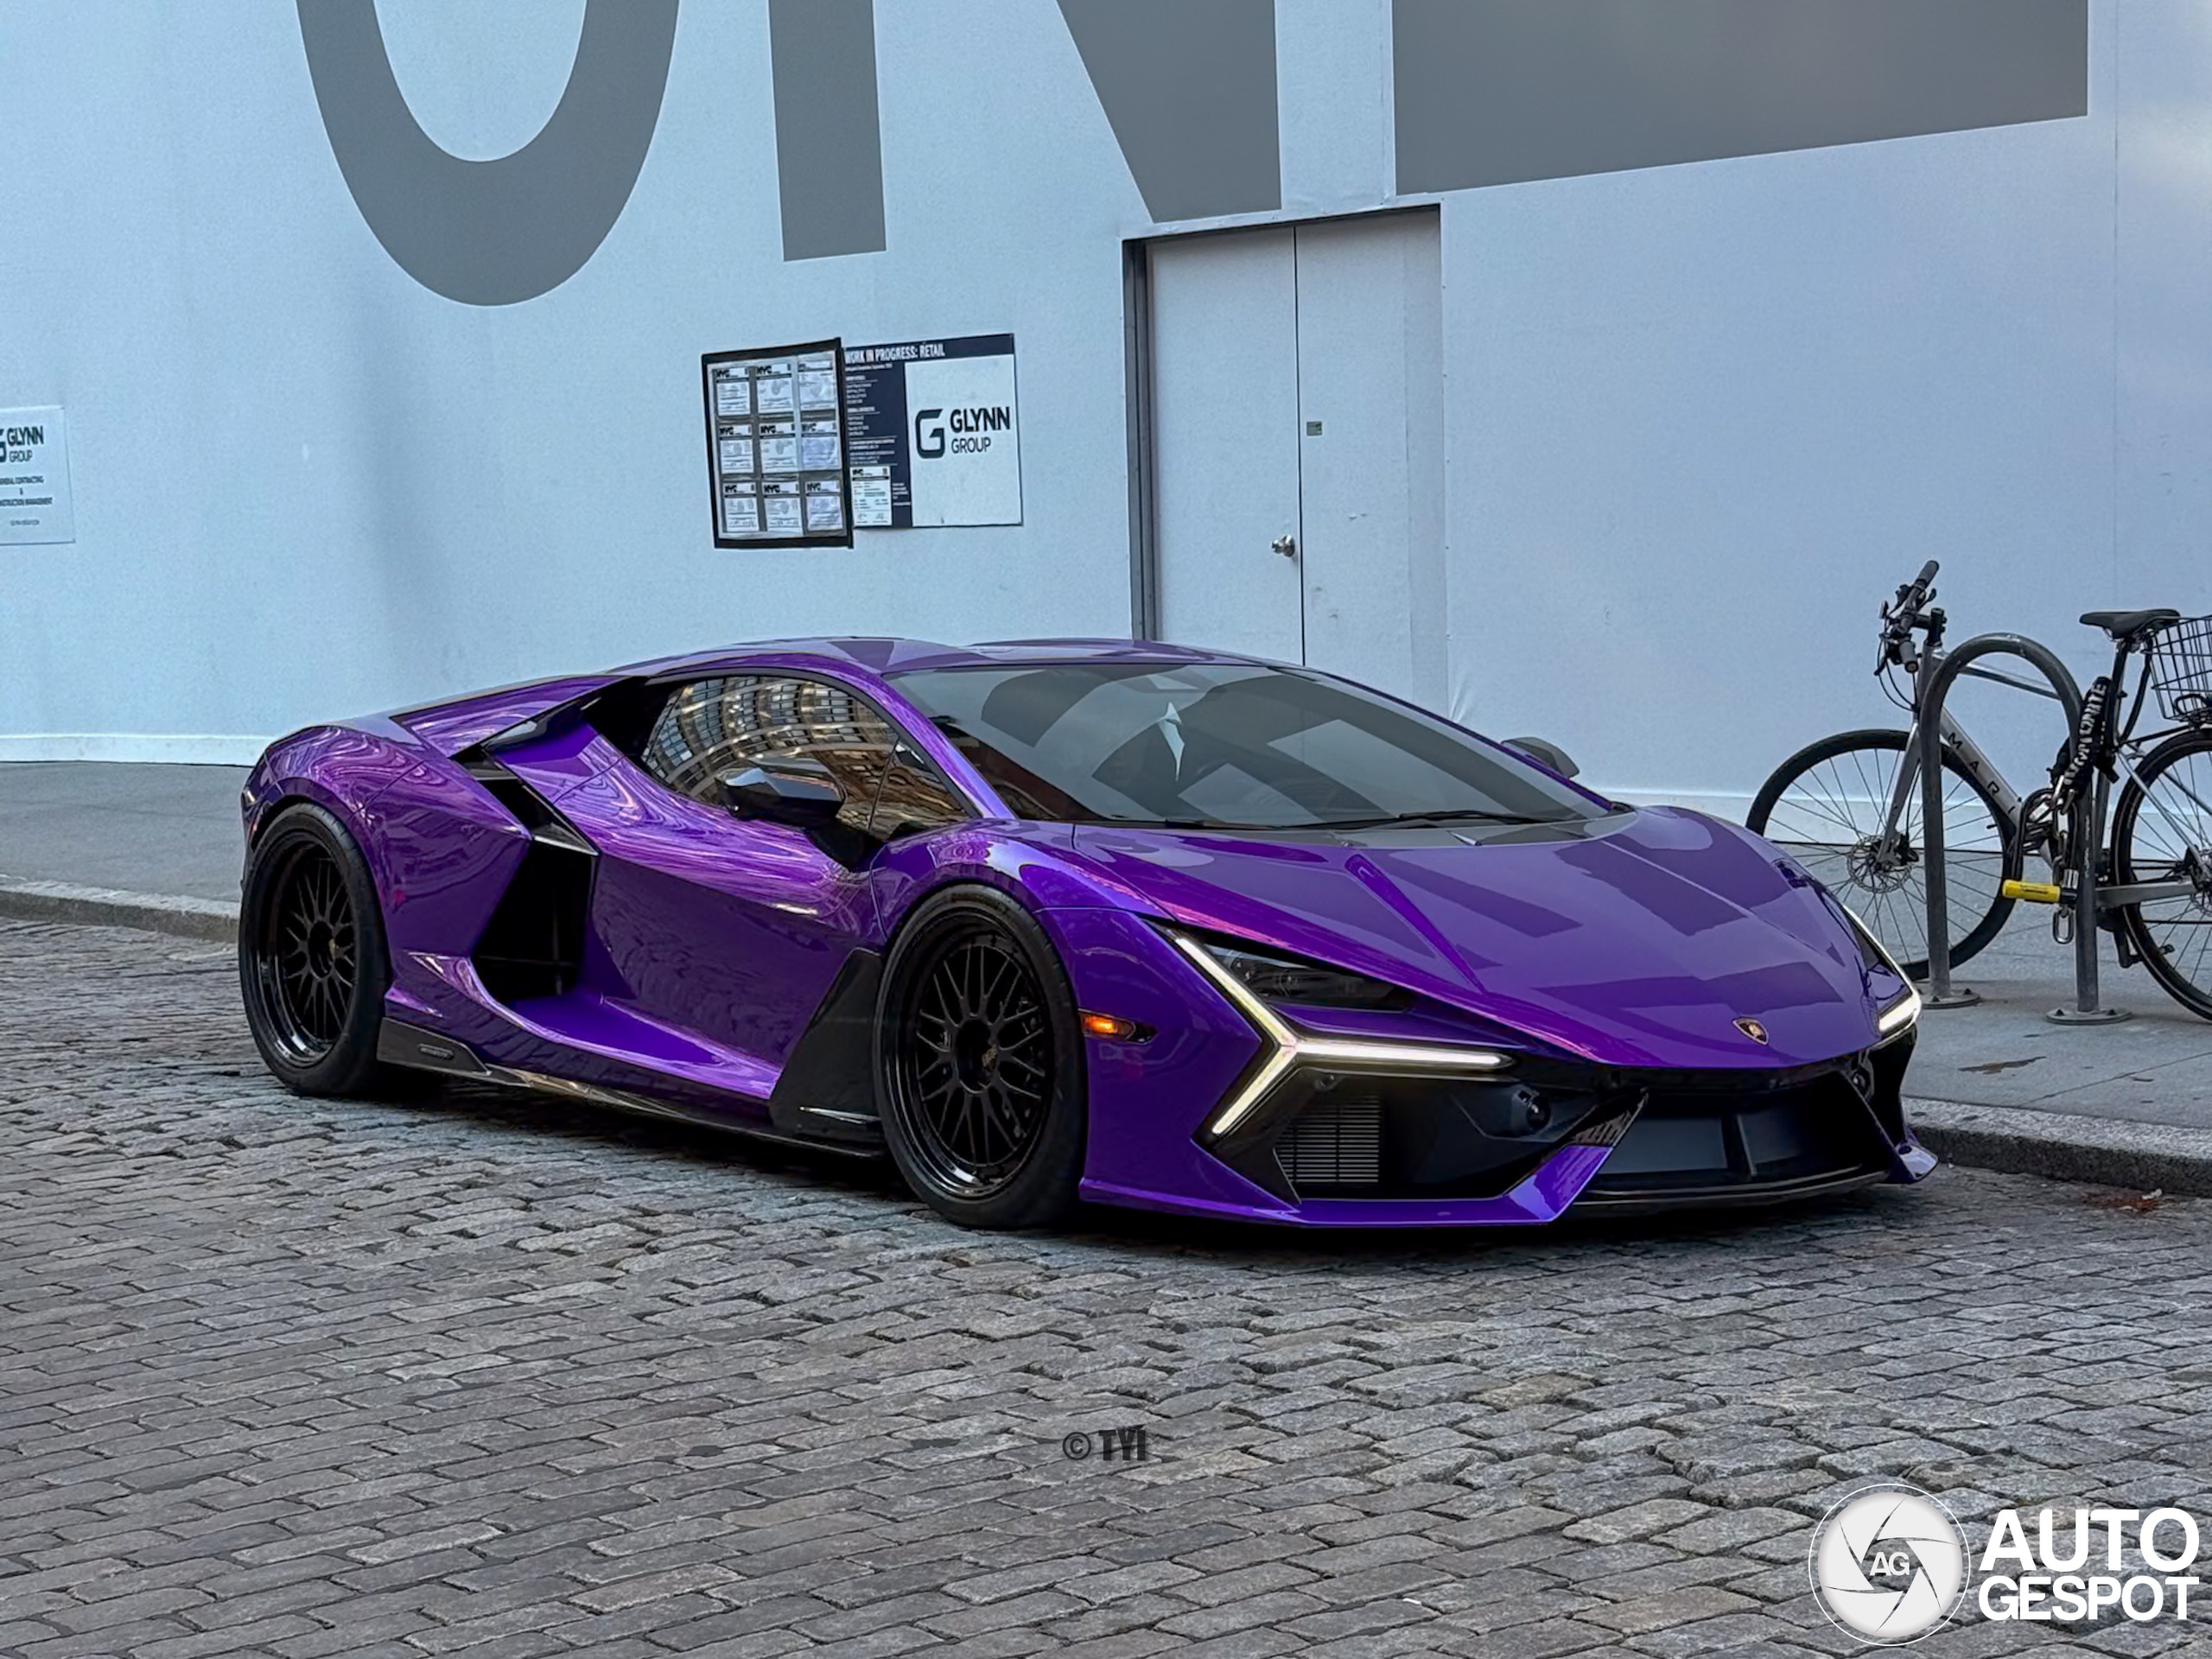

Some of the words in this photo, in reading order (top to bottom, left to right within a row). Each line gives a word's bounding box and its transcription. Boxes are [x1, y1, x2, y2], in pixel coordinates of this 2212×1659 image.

[844, 350, 865, 364] WORK
[866, 349, 874, 362] IN
[875, 346, 918, 361] PROGRESS:
[919, 343, 945, 358] RETAIL
[950, 406, 1010, 434] GLYNN
[7, 426, 44, 446] GLYNN
[951, 436, 991, 454] GROUP
[9, 449, 33, 462] GROUP
[763, 485, 780, 493] NYC
